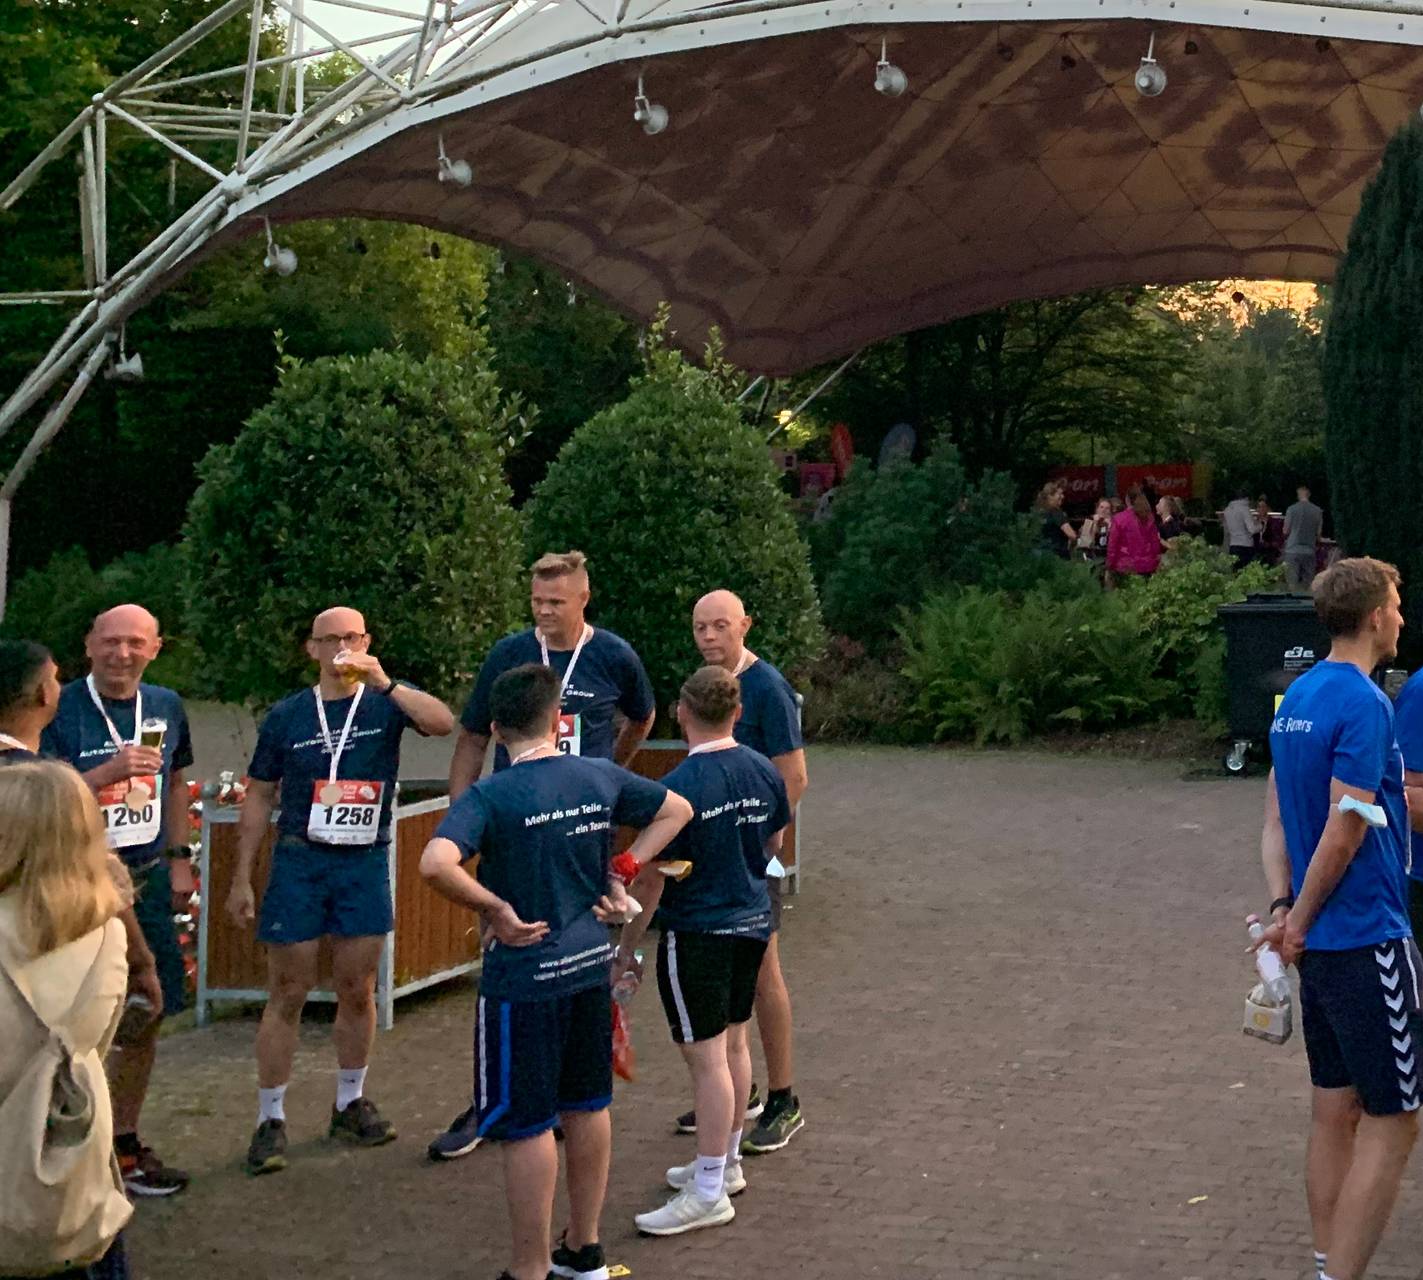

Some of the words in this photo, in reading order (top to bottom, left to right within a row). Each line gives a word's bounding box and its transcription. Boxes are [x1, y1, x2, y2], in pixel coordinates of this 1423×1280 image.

[351, 728, 382, 738] GROUP
[323, 806, 374, 826] 1258
[524, 812, 551, 827] Mehr
[565, 807, 580, 817] nur
[581, 802, 602, 815] Teile
[701, 806, 724, 820] Mehr
[742, 798, 760, 808] Teile
